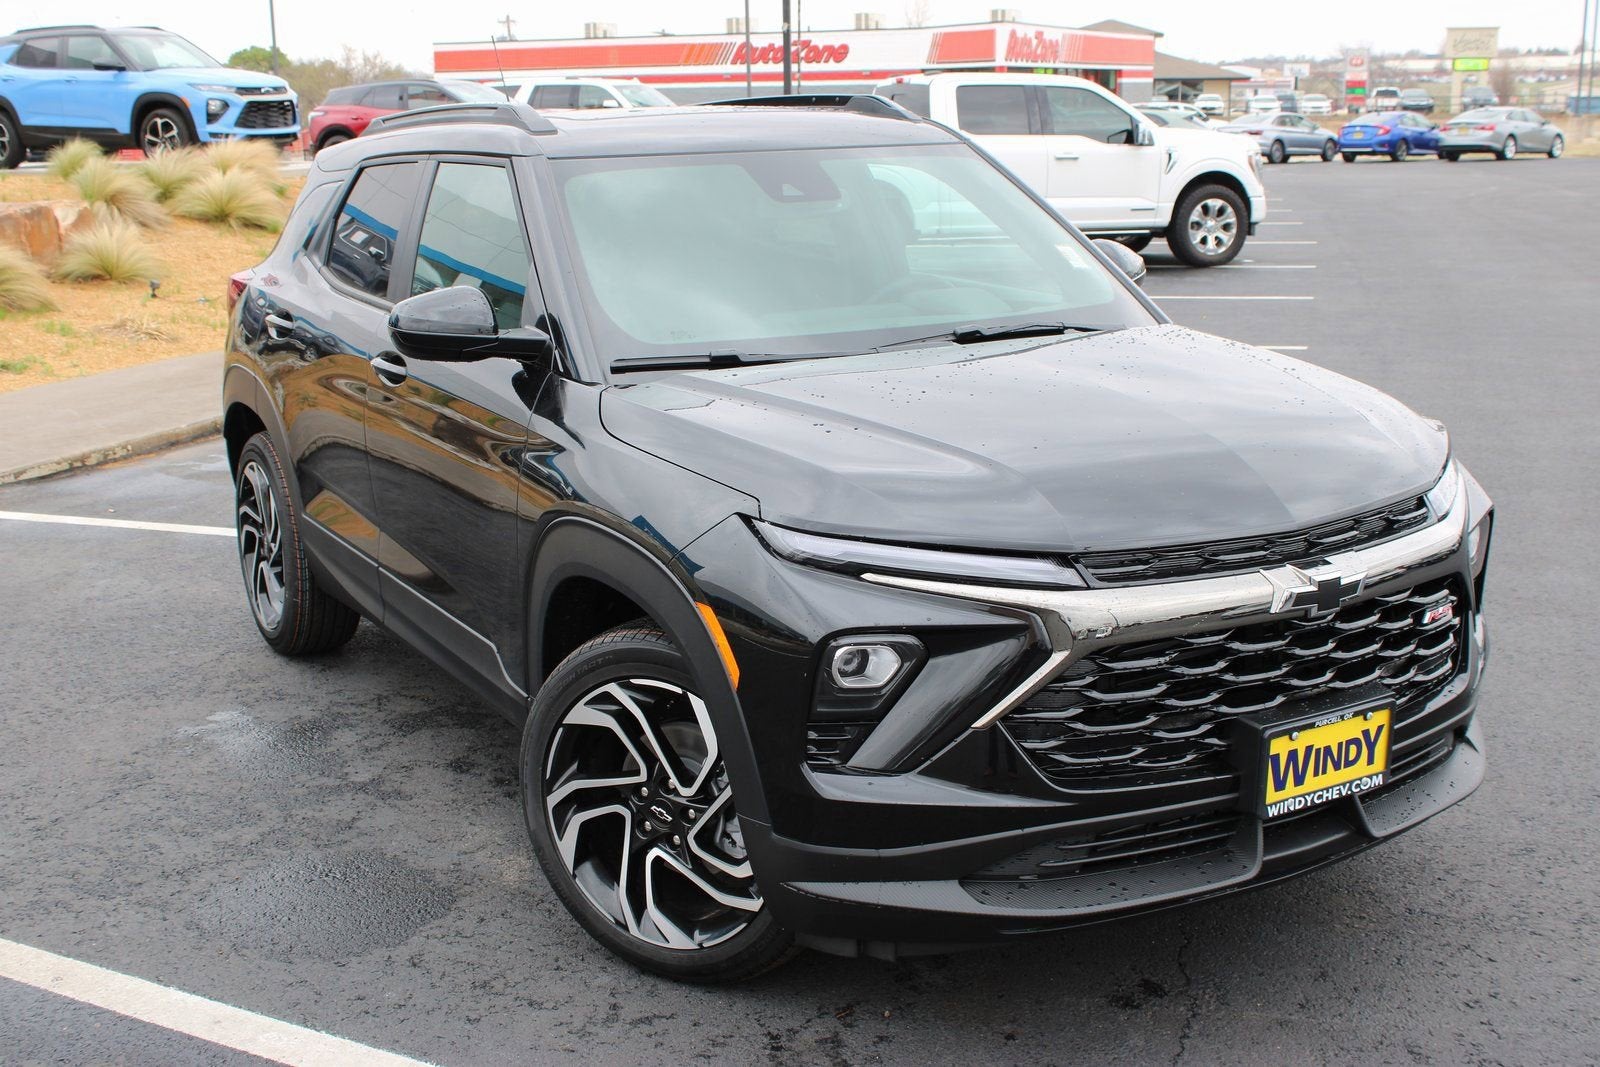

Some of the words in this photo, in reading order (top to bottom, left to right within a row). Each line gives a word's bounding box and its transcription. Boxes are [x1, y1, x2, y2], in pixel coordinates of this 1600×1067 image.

[730, 39, 850, 65] AutoZone
[1004, 29, 1060, 64] AutoZone
[1268, 723, 1386, 793] WINDY
[1267, 774, 1383, 818] WINDYCHEV.COM
